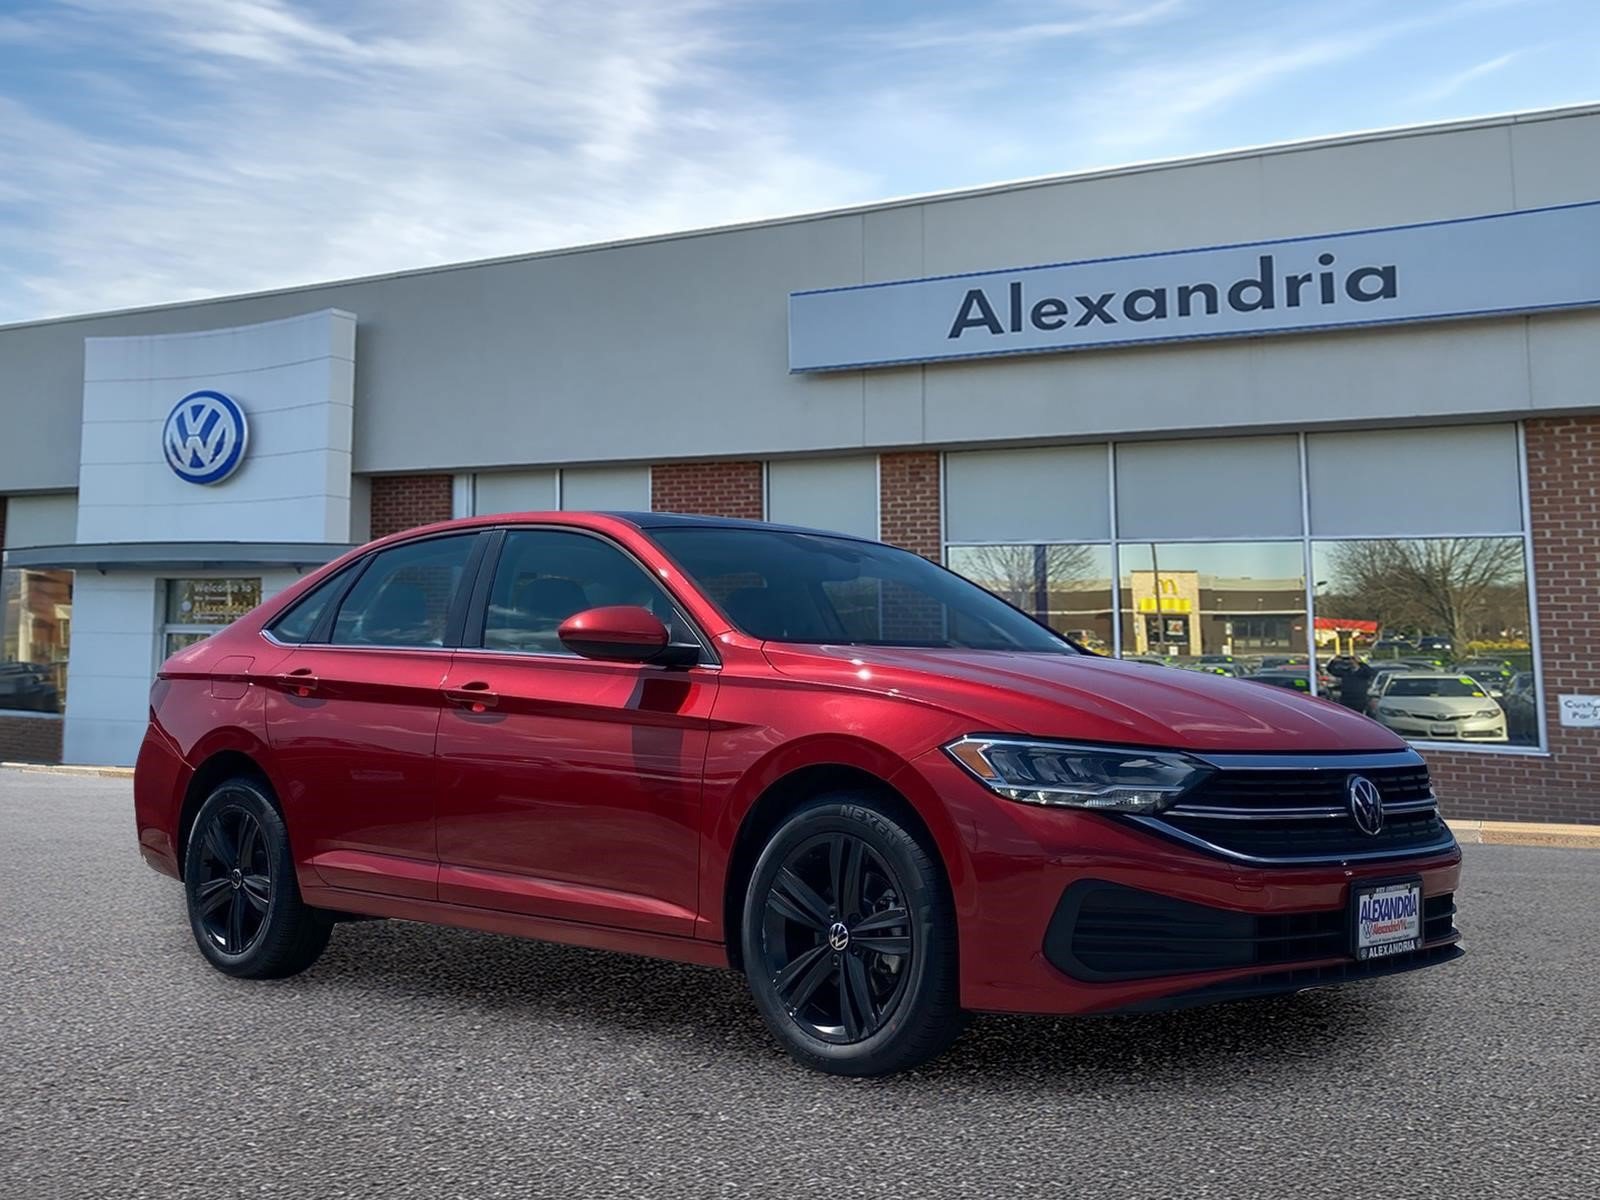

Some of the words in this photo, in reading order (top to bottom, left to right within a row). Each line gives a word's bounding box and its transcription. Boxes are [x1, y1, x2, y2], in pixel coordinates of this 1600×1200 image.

[947, 252, 1398, 340] Alexandria
[839, 804, 897, 845] NEXEN
[1360, 893, 1417, 925] ALEXANDRIA
[1368, 939, 1416, 959] ALEXANDRIA
